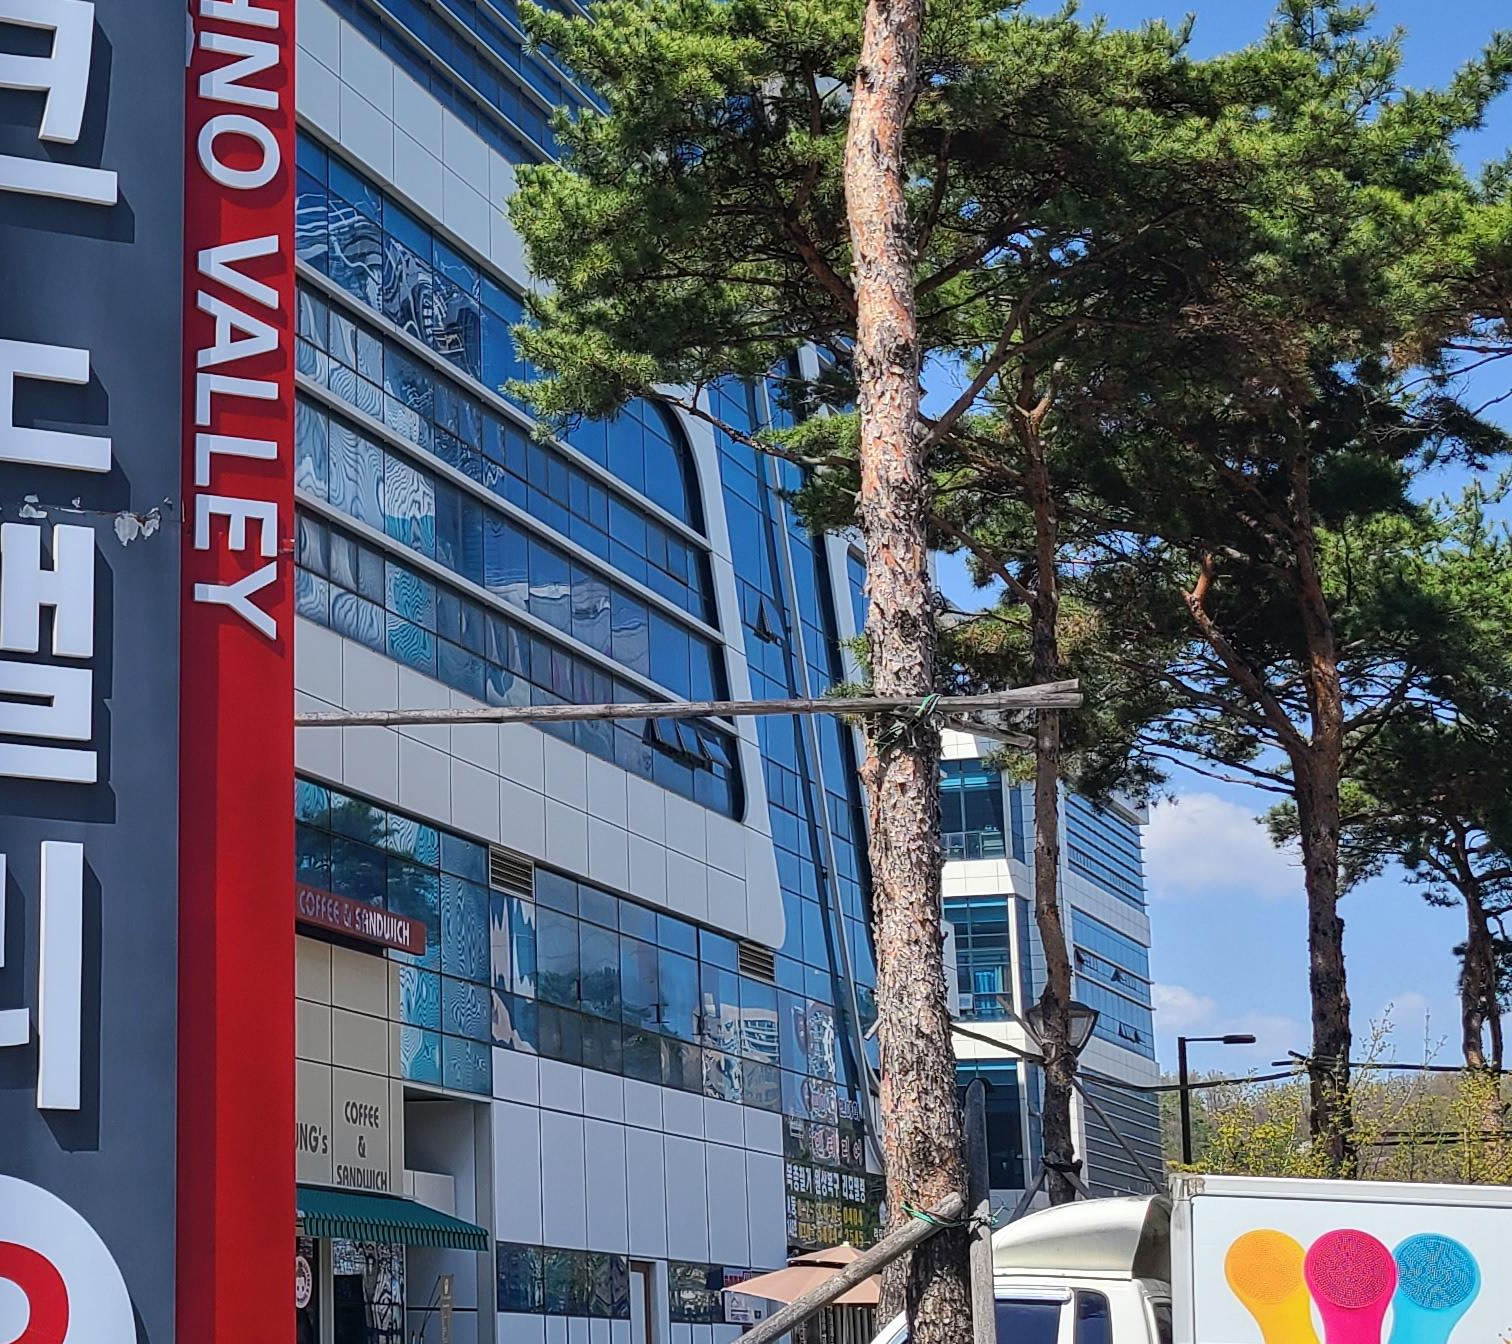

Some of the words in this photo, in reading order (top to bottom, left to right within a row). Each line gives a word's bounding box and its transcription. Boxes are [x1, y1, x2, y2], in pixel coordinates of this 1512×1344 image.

[193, 233, 280, 642] VALLEY
[299, 889, 340, 925] COFFEE
[343, 903, 352, 928] &
[355, 907, 410, 947] SANDWICH
[344, 1100, 379, 1129] COFFEE
[296, 1122, 328, 1154] NG's
[357, 1135, 366, 1158] &
[336, 1164, 388, 1192] SANDWICH
